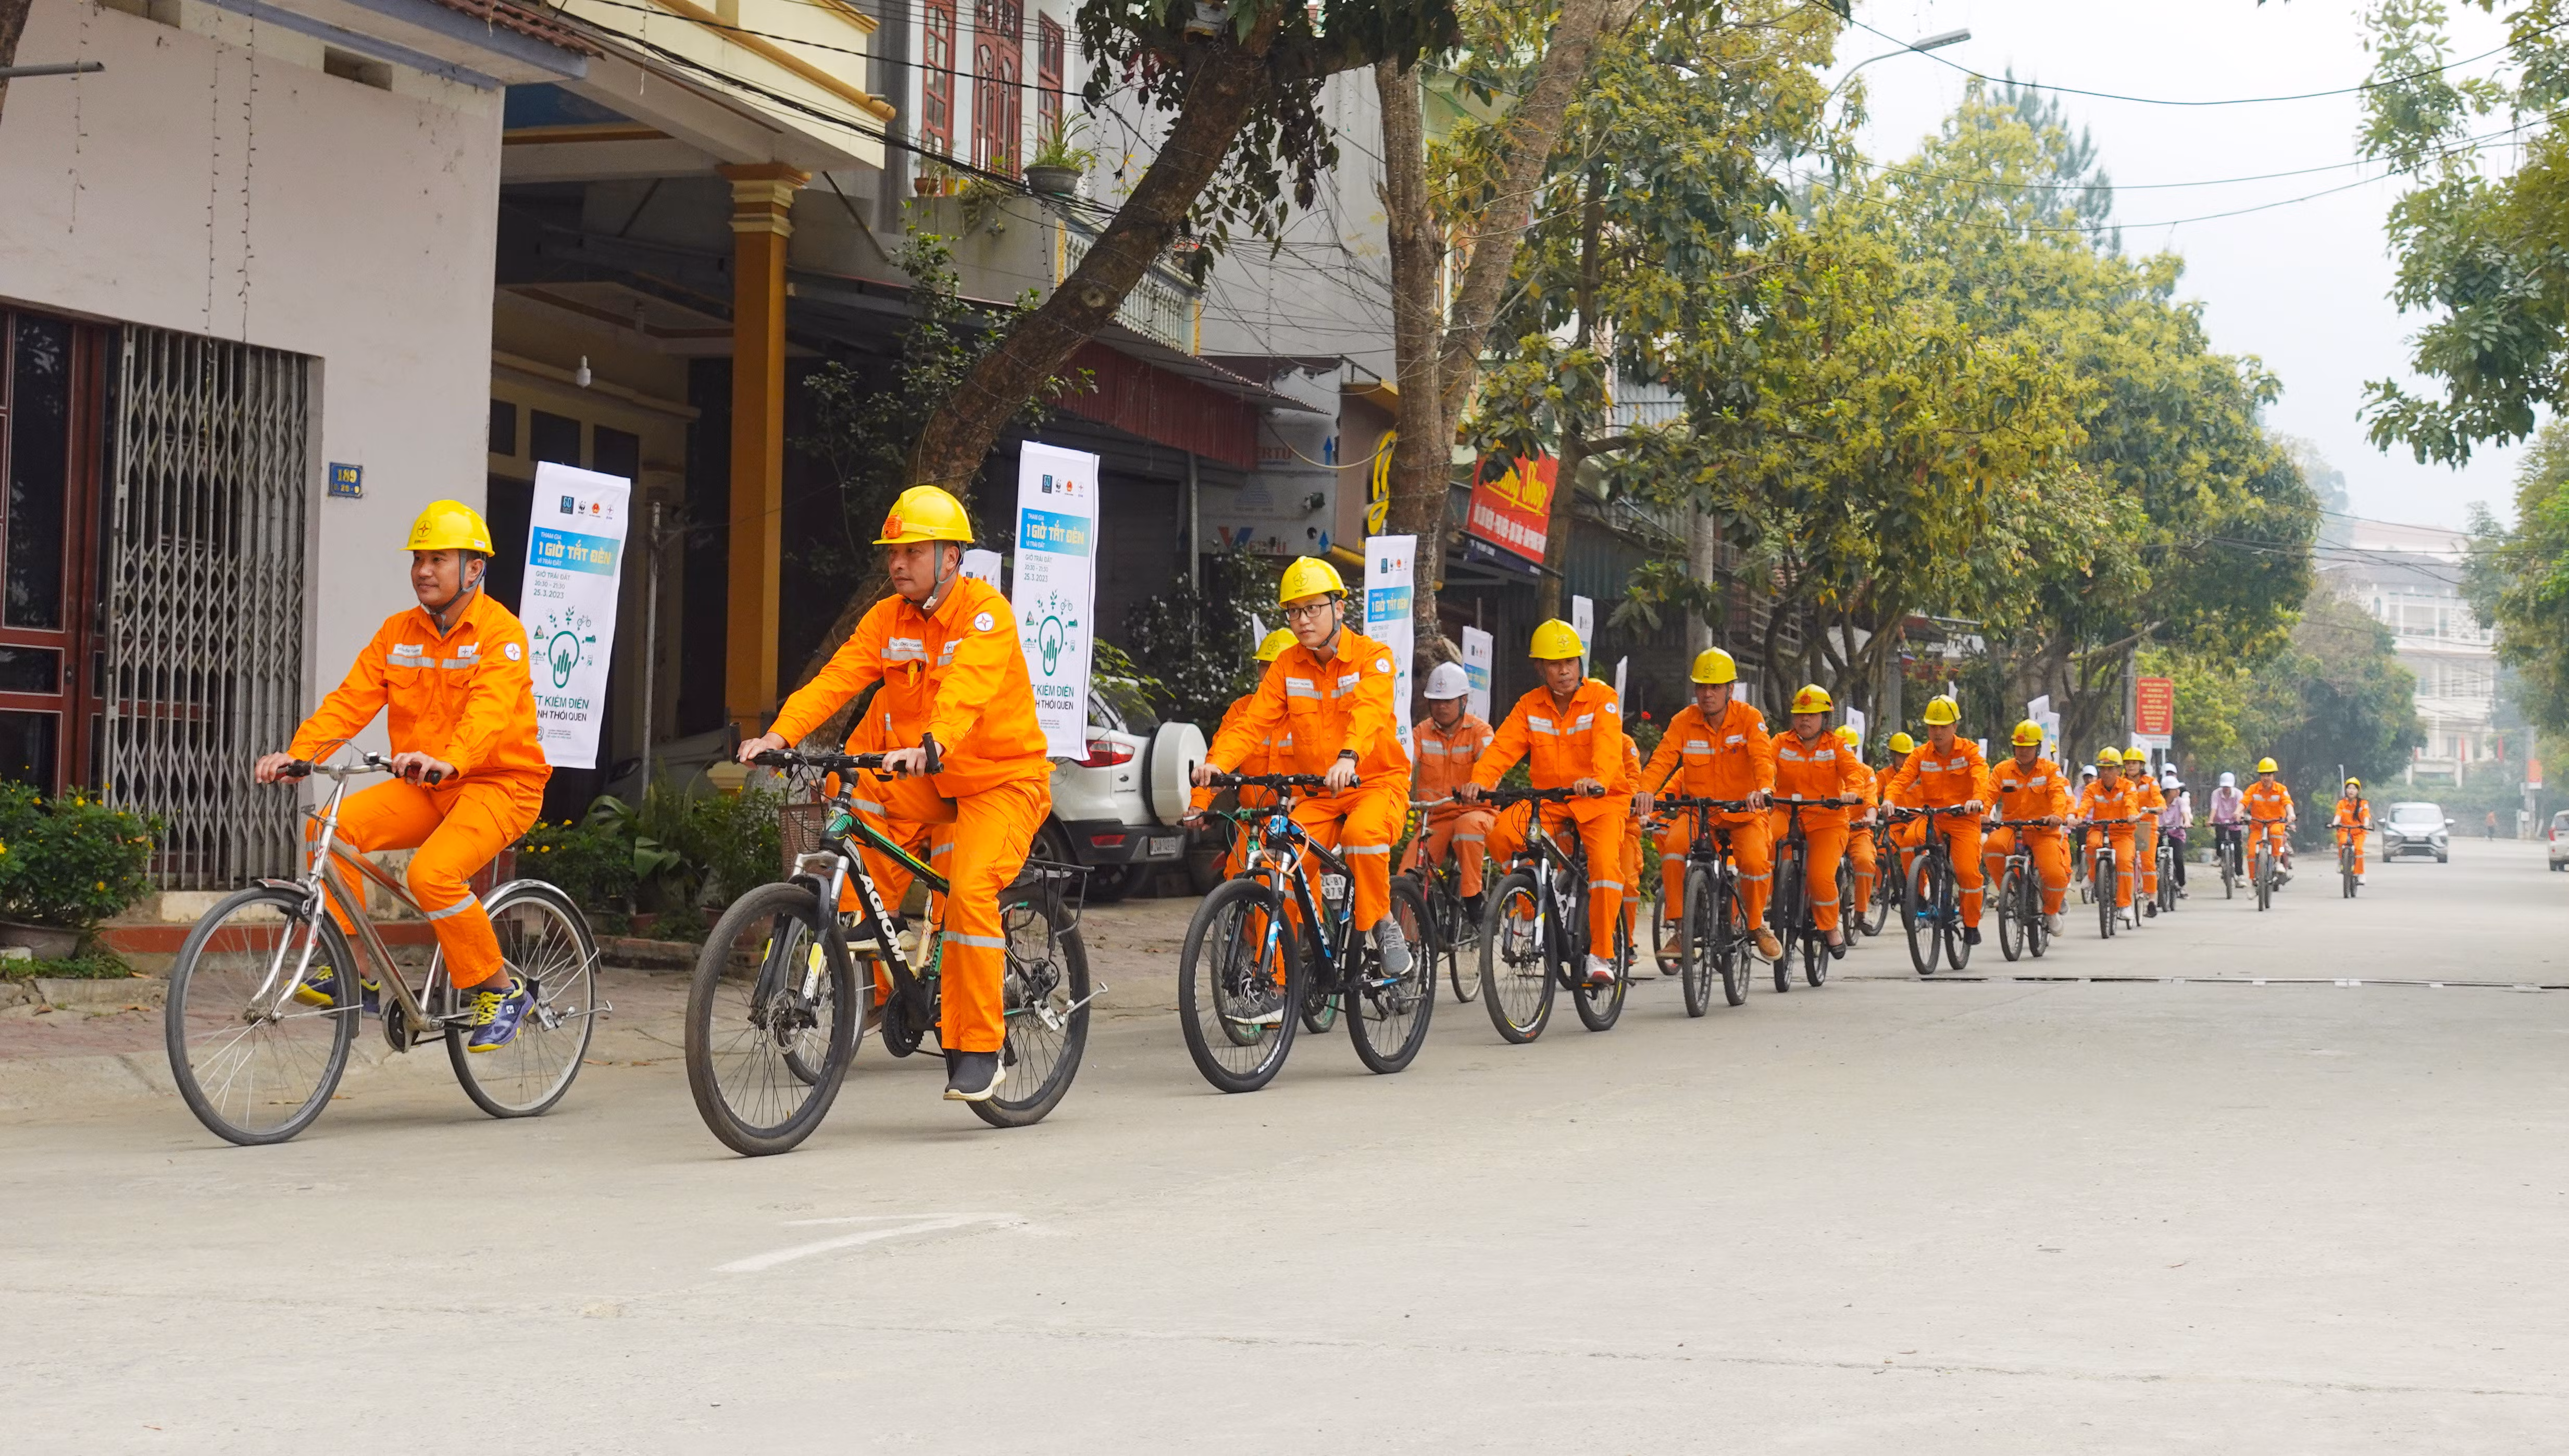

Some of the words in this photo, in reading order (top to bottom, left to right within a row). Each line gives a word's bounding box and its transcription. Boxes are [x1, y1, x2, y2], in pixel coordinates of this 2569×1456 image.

[539, 542, 542, 555] 1
[545, 541, 565, 557] GIỜ
[568, 539, 589, 561] TẮT
[590, 547, 612, 564] ĐÈN
[1037, 683, 1055, 697] KIỆM
[1057, 684, 1074, 698] ĐIỆN
[545, 694, 567, 708] KIỆM
[569, 696, 589, 710] ĐIỆN
[1057, 701, 1074, 710] QUEN
[569, 711, 587, 722] QUEN
[859, 873, 906, 962] AGIOM
